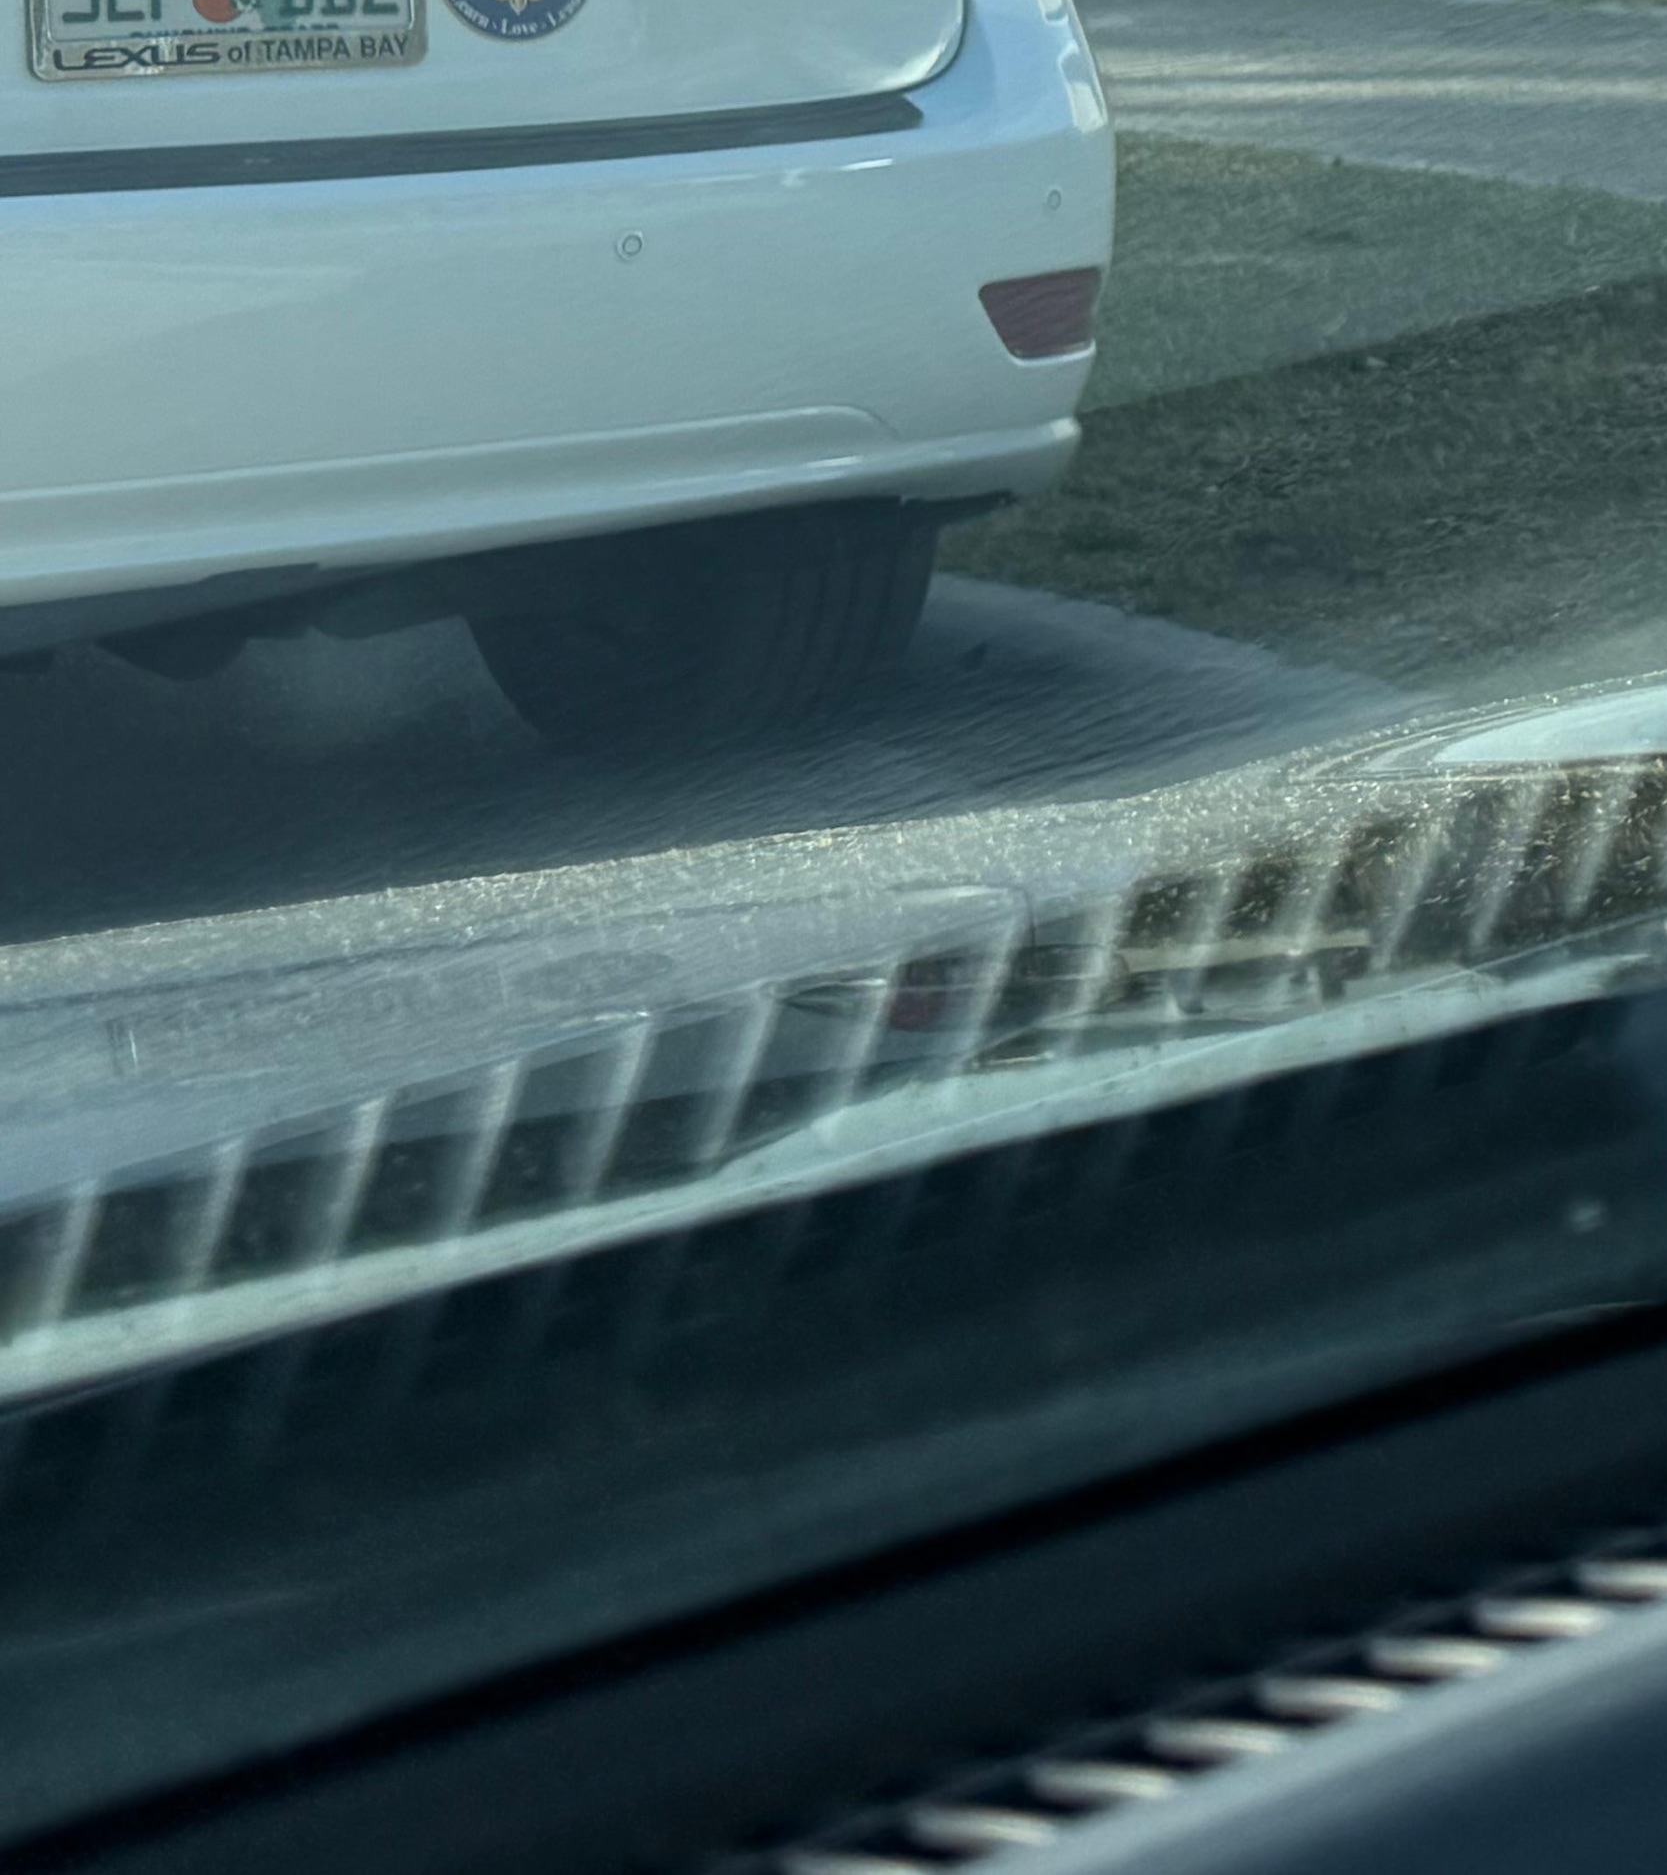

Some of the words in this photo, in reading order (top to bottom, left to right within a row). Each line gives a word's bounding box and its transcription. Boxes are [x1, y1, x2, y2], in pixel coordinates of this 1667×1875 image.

[52, 42, 221, 71] LEXUS
[227, 40, 251, 64] of
[260, 34, 351, 62] TAMPA
[358, 32, 409, 59] BAY
